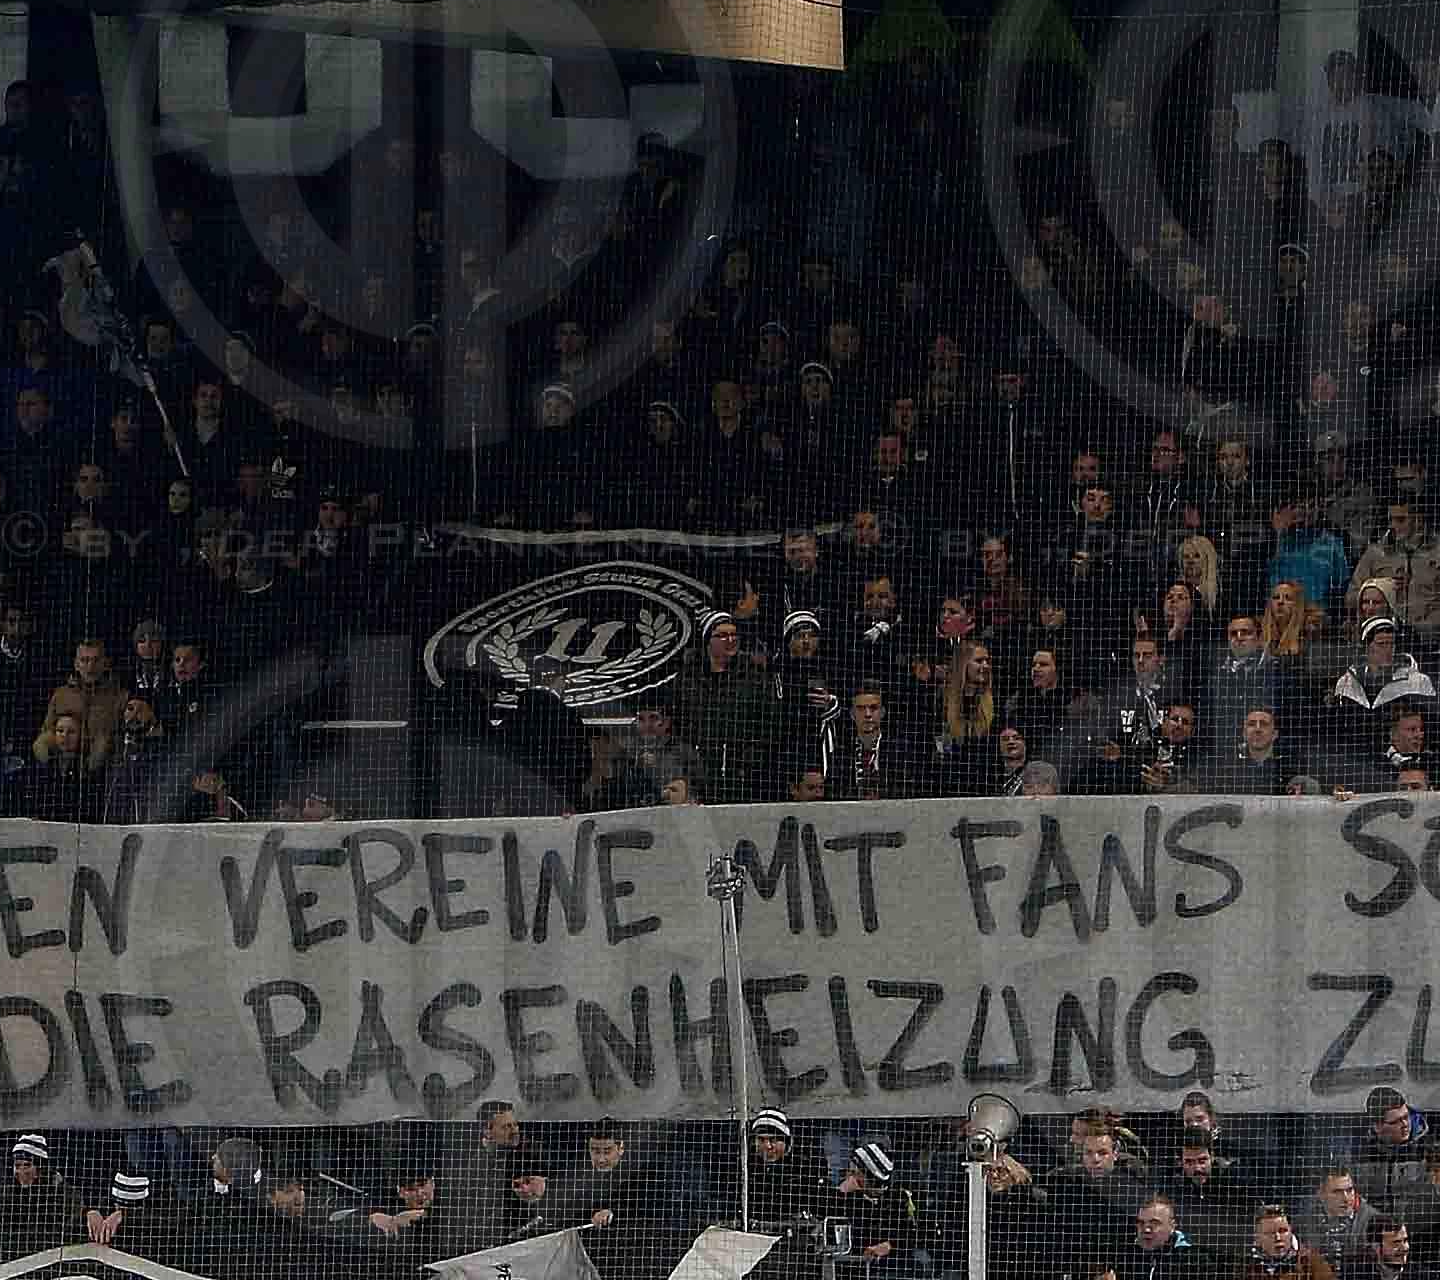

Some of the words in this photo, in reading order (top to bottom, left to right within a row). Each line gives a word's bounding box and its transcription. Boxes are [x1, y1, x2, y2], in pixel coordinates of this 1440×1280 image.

[220, 819, 665, 954] VEREINE
[733, 812, 907, 937] MIT
[950, 802, 1246, 940] FANS
[243, 971, 1217, 1115] RASENHEIZUNG
